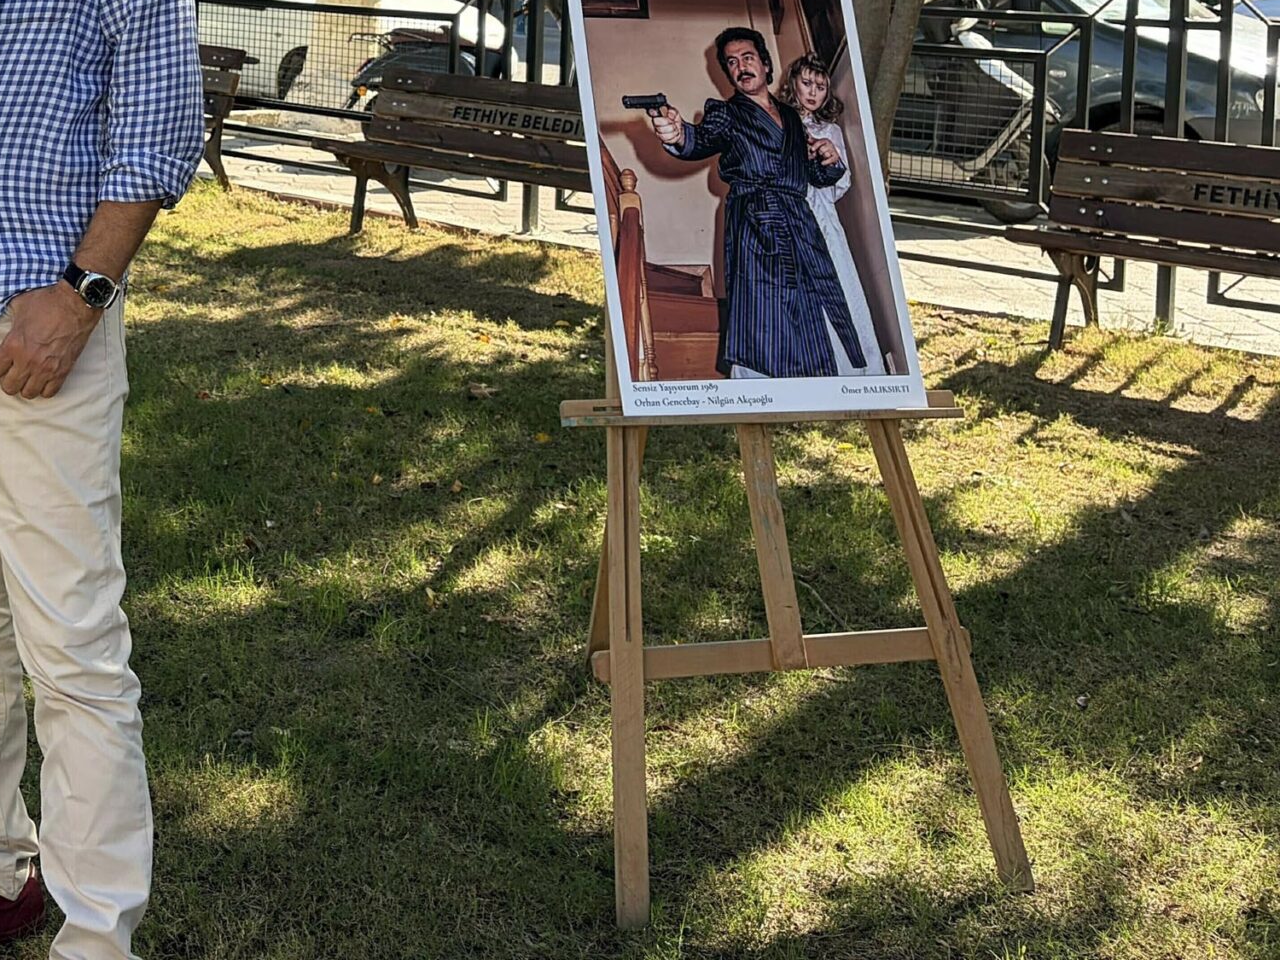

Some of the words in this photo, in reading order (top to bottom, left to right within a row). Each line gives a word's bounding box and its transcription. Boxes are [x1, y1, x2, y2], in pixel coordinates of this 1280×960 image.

[452, 105, 518, 127] FETHİYE
[521, 114, 586, 136] BELEDİ
[632, 383, 658, 393] Sensiz
[701, 383, 719, 393] 1989
[841, 384, 862, 394] Ömer
[634, 397, 661, 408] Orhan
[662, 397, 700, 409] Gencebay
[707, 396, 735, 407] Nilgün
